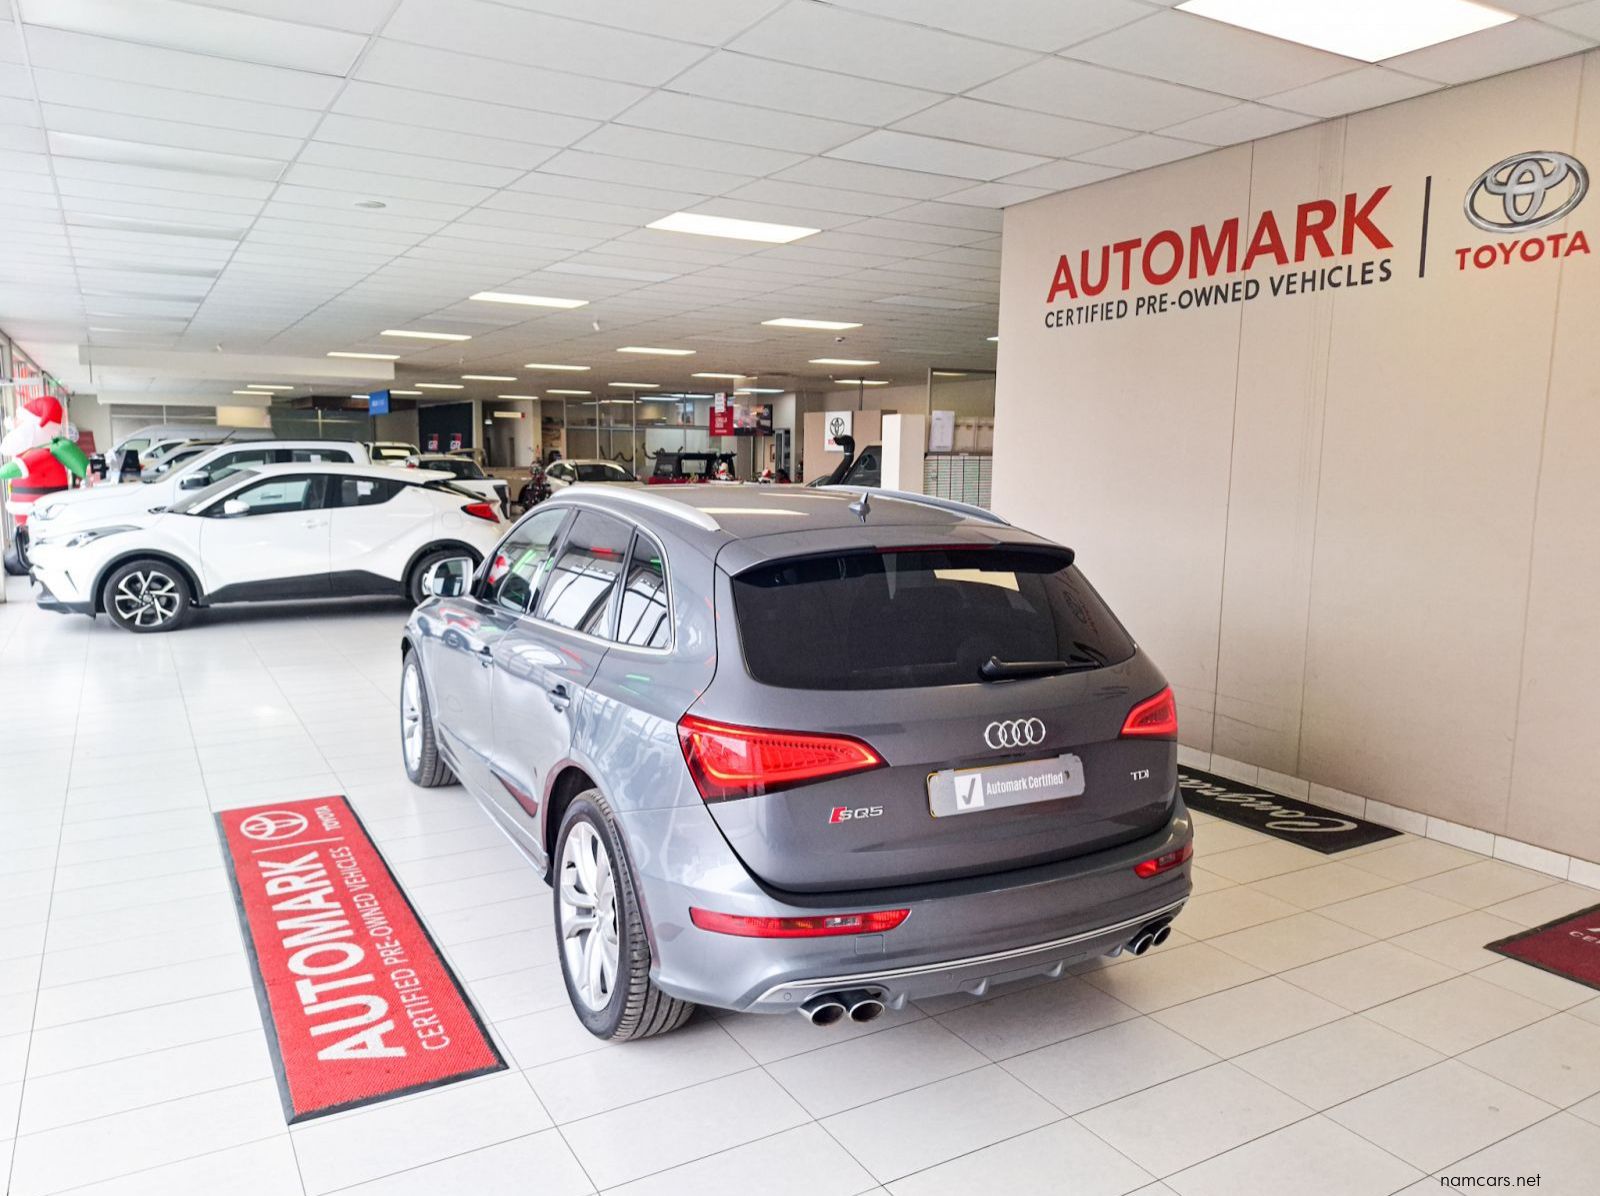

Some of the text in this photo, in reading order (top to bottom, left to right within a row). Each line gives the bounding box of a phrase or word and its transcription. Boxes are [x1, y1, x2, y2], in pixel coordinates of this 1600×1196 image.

[1046, 185, 1394, 303] AUTOMARK
[1455, 230, 1591, 271] TOYOTA
[1045, 259, 1393, 328] CERTIFIED PRE-OWNED VEHICLES
[986, 772, 1064, 795] Automark Certified
[1130, 768, 1150, 780] TDI
[836, 805, 884, 822] SQ5
[257, 850, 407, 1062] AUTOMARK
[328, 847, 451, 1051] CERTIFIED PRE-OWNED VEHICLES
